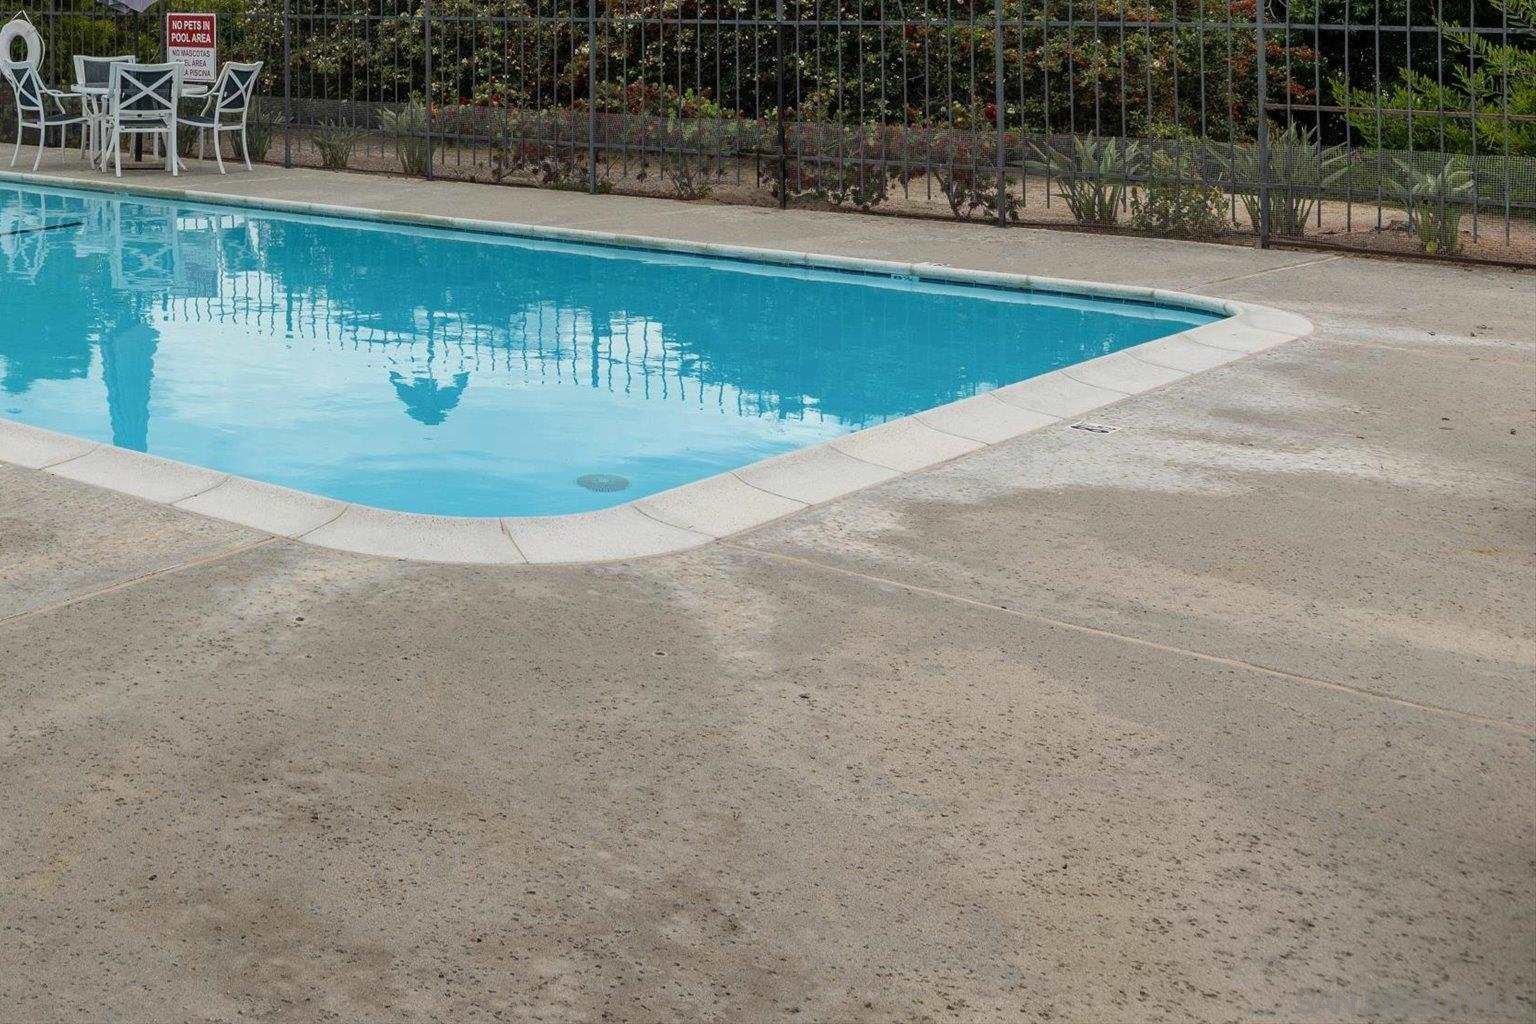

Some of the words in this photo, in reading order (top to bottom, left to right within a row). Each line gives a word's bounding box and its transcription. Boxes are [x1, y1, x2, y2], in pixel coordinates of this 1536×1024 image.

[172, 21, 182, 29] NO
[184, 21, 202, 30] PETS
[203, 21, 211, 30] IN
[171, 33, 190, 43] POOL
[192, 34, 212, 43] AREA
[172, 49, 180, 57] NO
[181, 49, 211, 57] MASCOTAS
